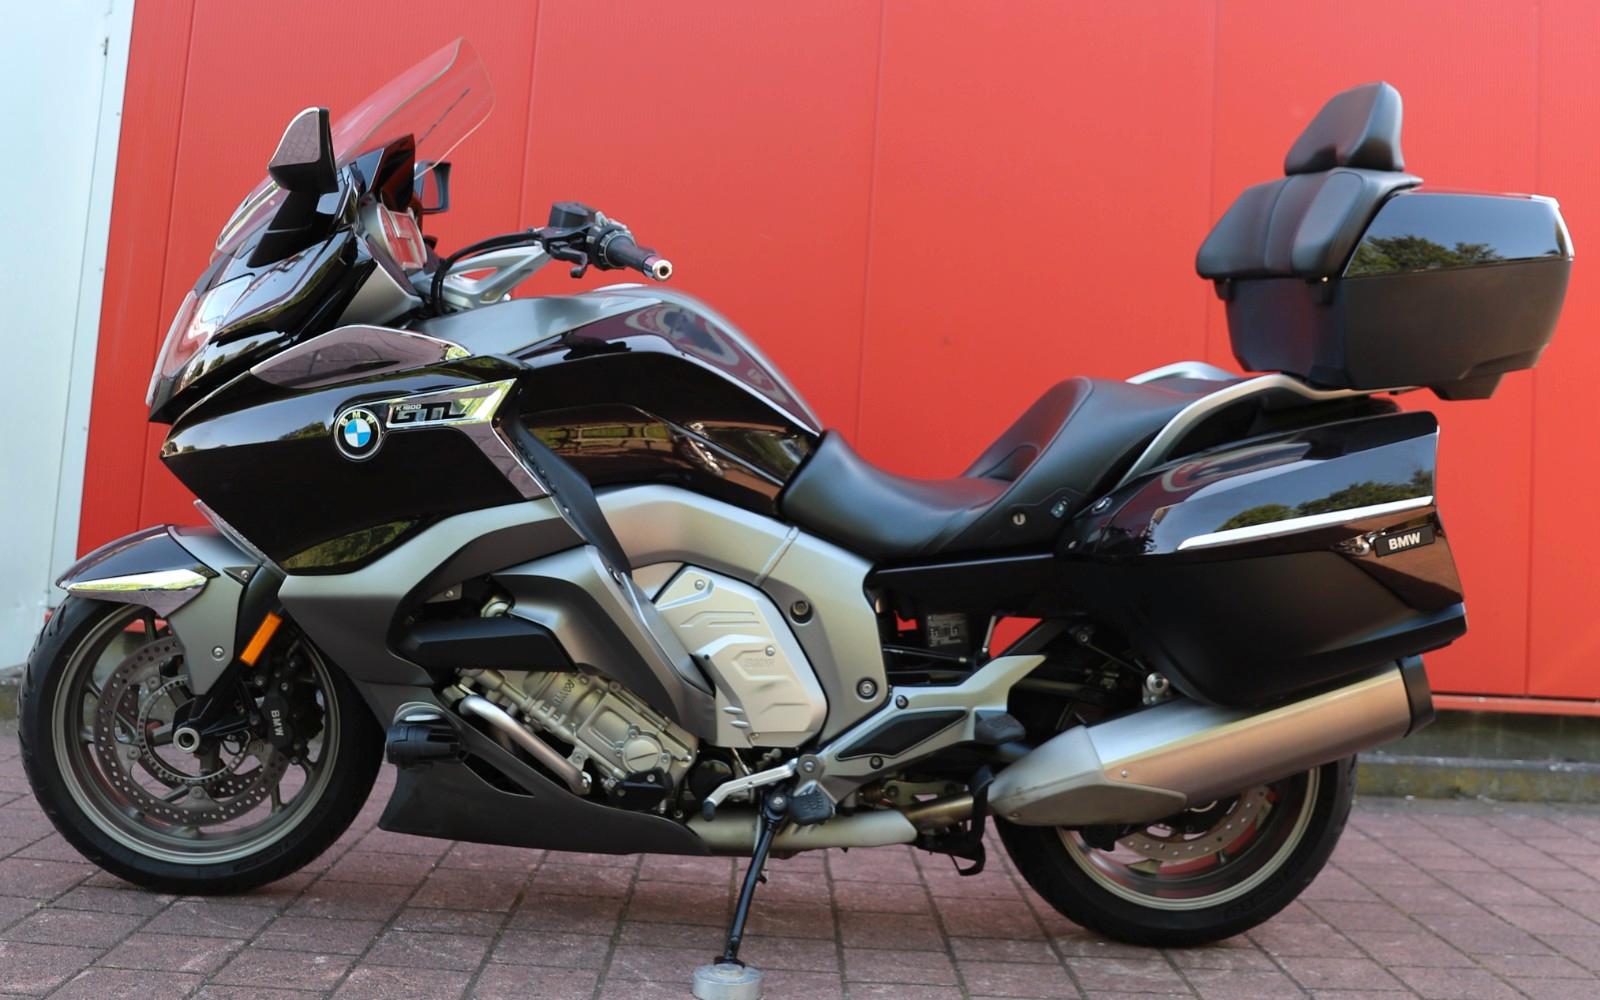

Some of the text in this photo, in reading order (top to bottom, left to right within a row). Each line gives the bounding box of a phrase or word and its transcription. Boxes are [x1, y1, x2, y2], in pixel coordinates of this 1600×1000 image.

[339, 410, 376, 427] BMW
[391, 402, 467, 424] GTL
[1388, 531, 1421, 551] BMW
[271, 710, 285, 736] BMW
